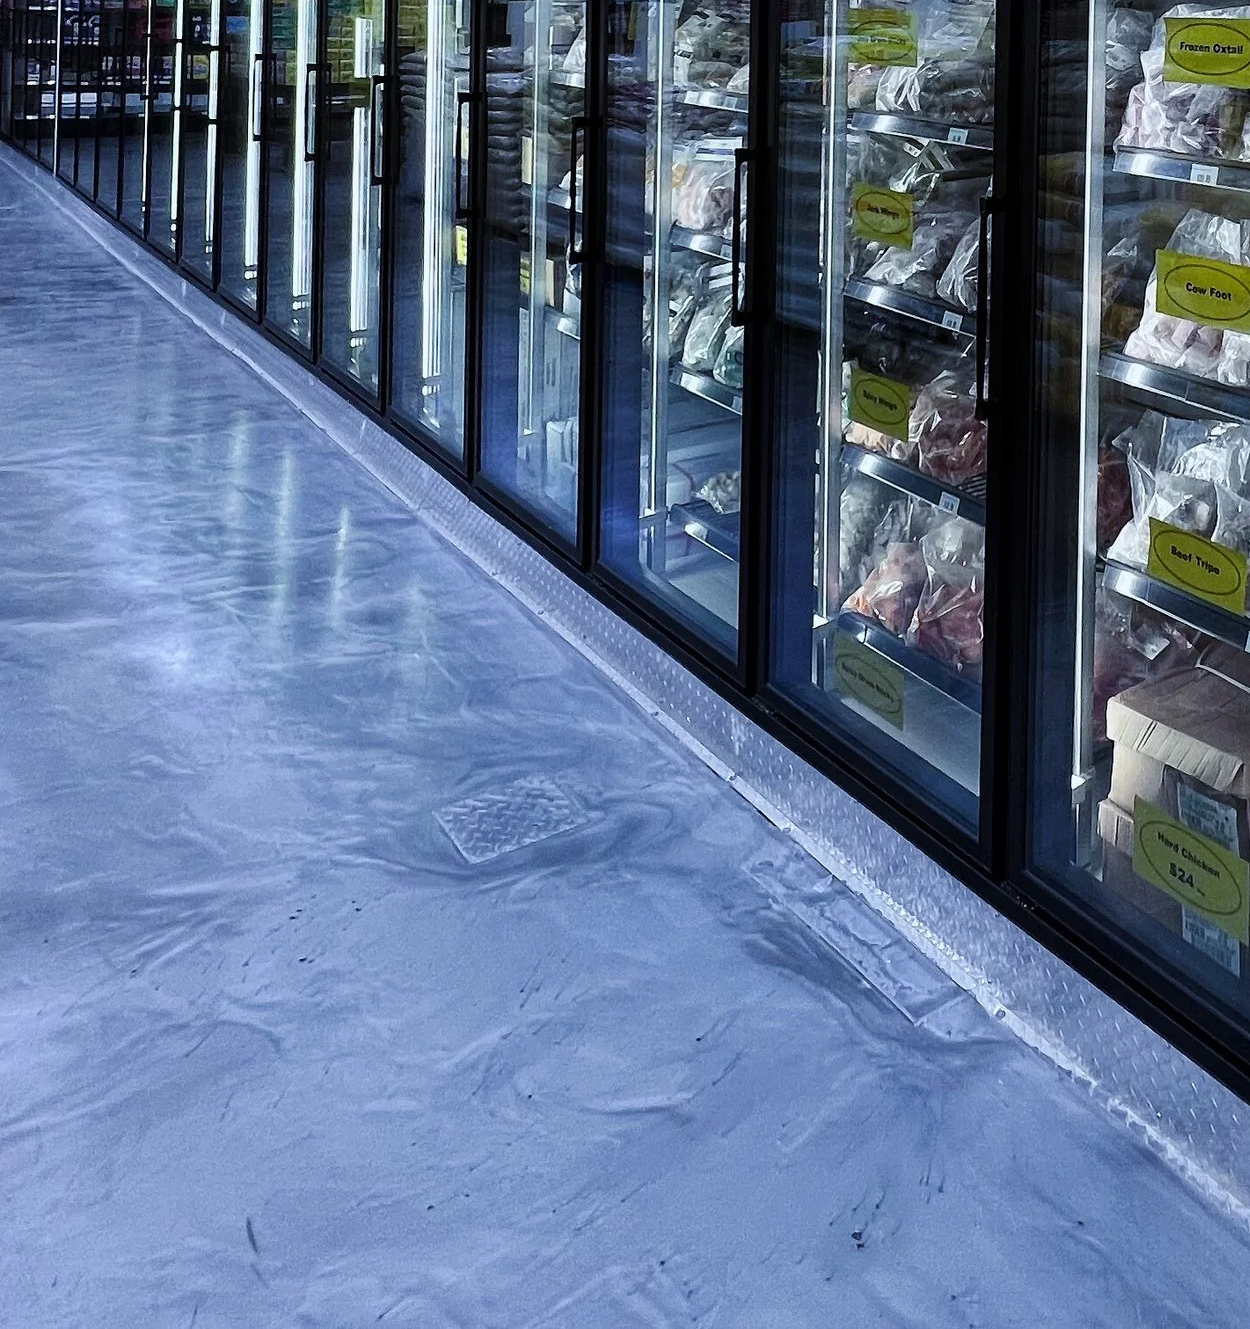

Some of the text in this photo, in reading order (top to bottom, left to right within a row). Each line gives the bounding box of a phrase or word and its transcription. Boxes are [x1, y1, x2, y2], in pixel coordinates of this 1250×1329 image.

[1179, 41, 1244, 55] Frozen Oxtail
[1185, 282, 1232, 301] Cow Foot
[1170, 545, 1220, 575] Beef Tripe
